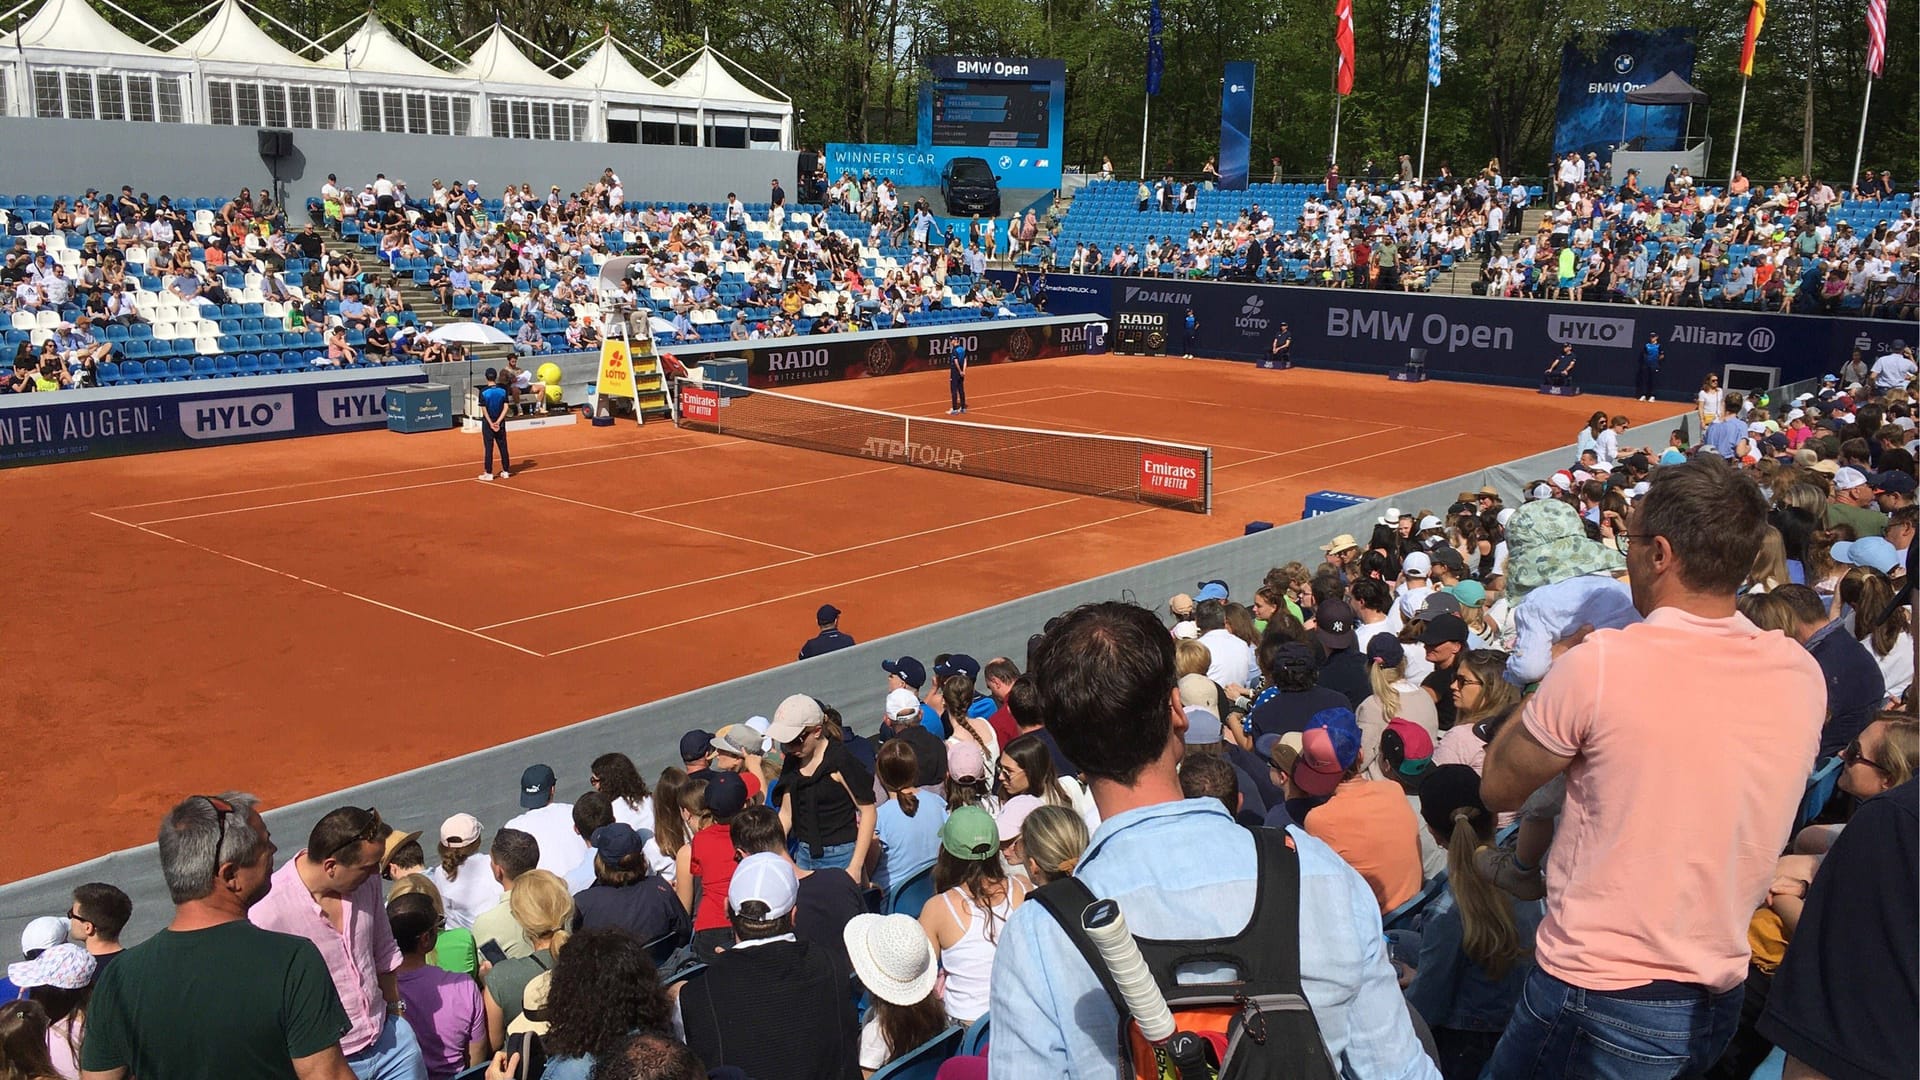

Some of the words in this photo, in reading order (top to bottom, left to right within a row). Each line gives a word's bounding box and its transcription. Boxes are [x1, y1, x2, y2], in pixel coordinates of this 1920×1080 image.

[957, 61, 991, 74] BMW
[994, 62, 1029, 76] Open
[1588, 82, 1621, 94] BMW
[835, 151, 905, 165] WINNER'S
[908, 153, 935, 165] CAR
[862, 167, 904, 176] EECTRIC
[1139, 290, 1192, 305] DAIKIN
[1119, 313, 1164, 326] RADO
[1327, 307, 1414, 342] BMW
[1422, 313, 1513, 353] Open
[1670, 325, 1744, 347] Allianz
[768, 348, 829, 371] RADO
[605, 368, 626, 381] LOTTO
[684, 392, 717, 407] Emirates
[860, 436, 904, 459] ATP
[904, 442, 965, 471] TOUR
[1144, 459, 1197, 480] Emirates
[1151, 475, 1163, 487] FLY
[1163, 476, 1188, 490] BETTER
